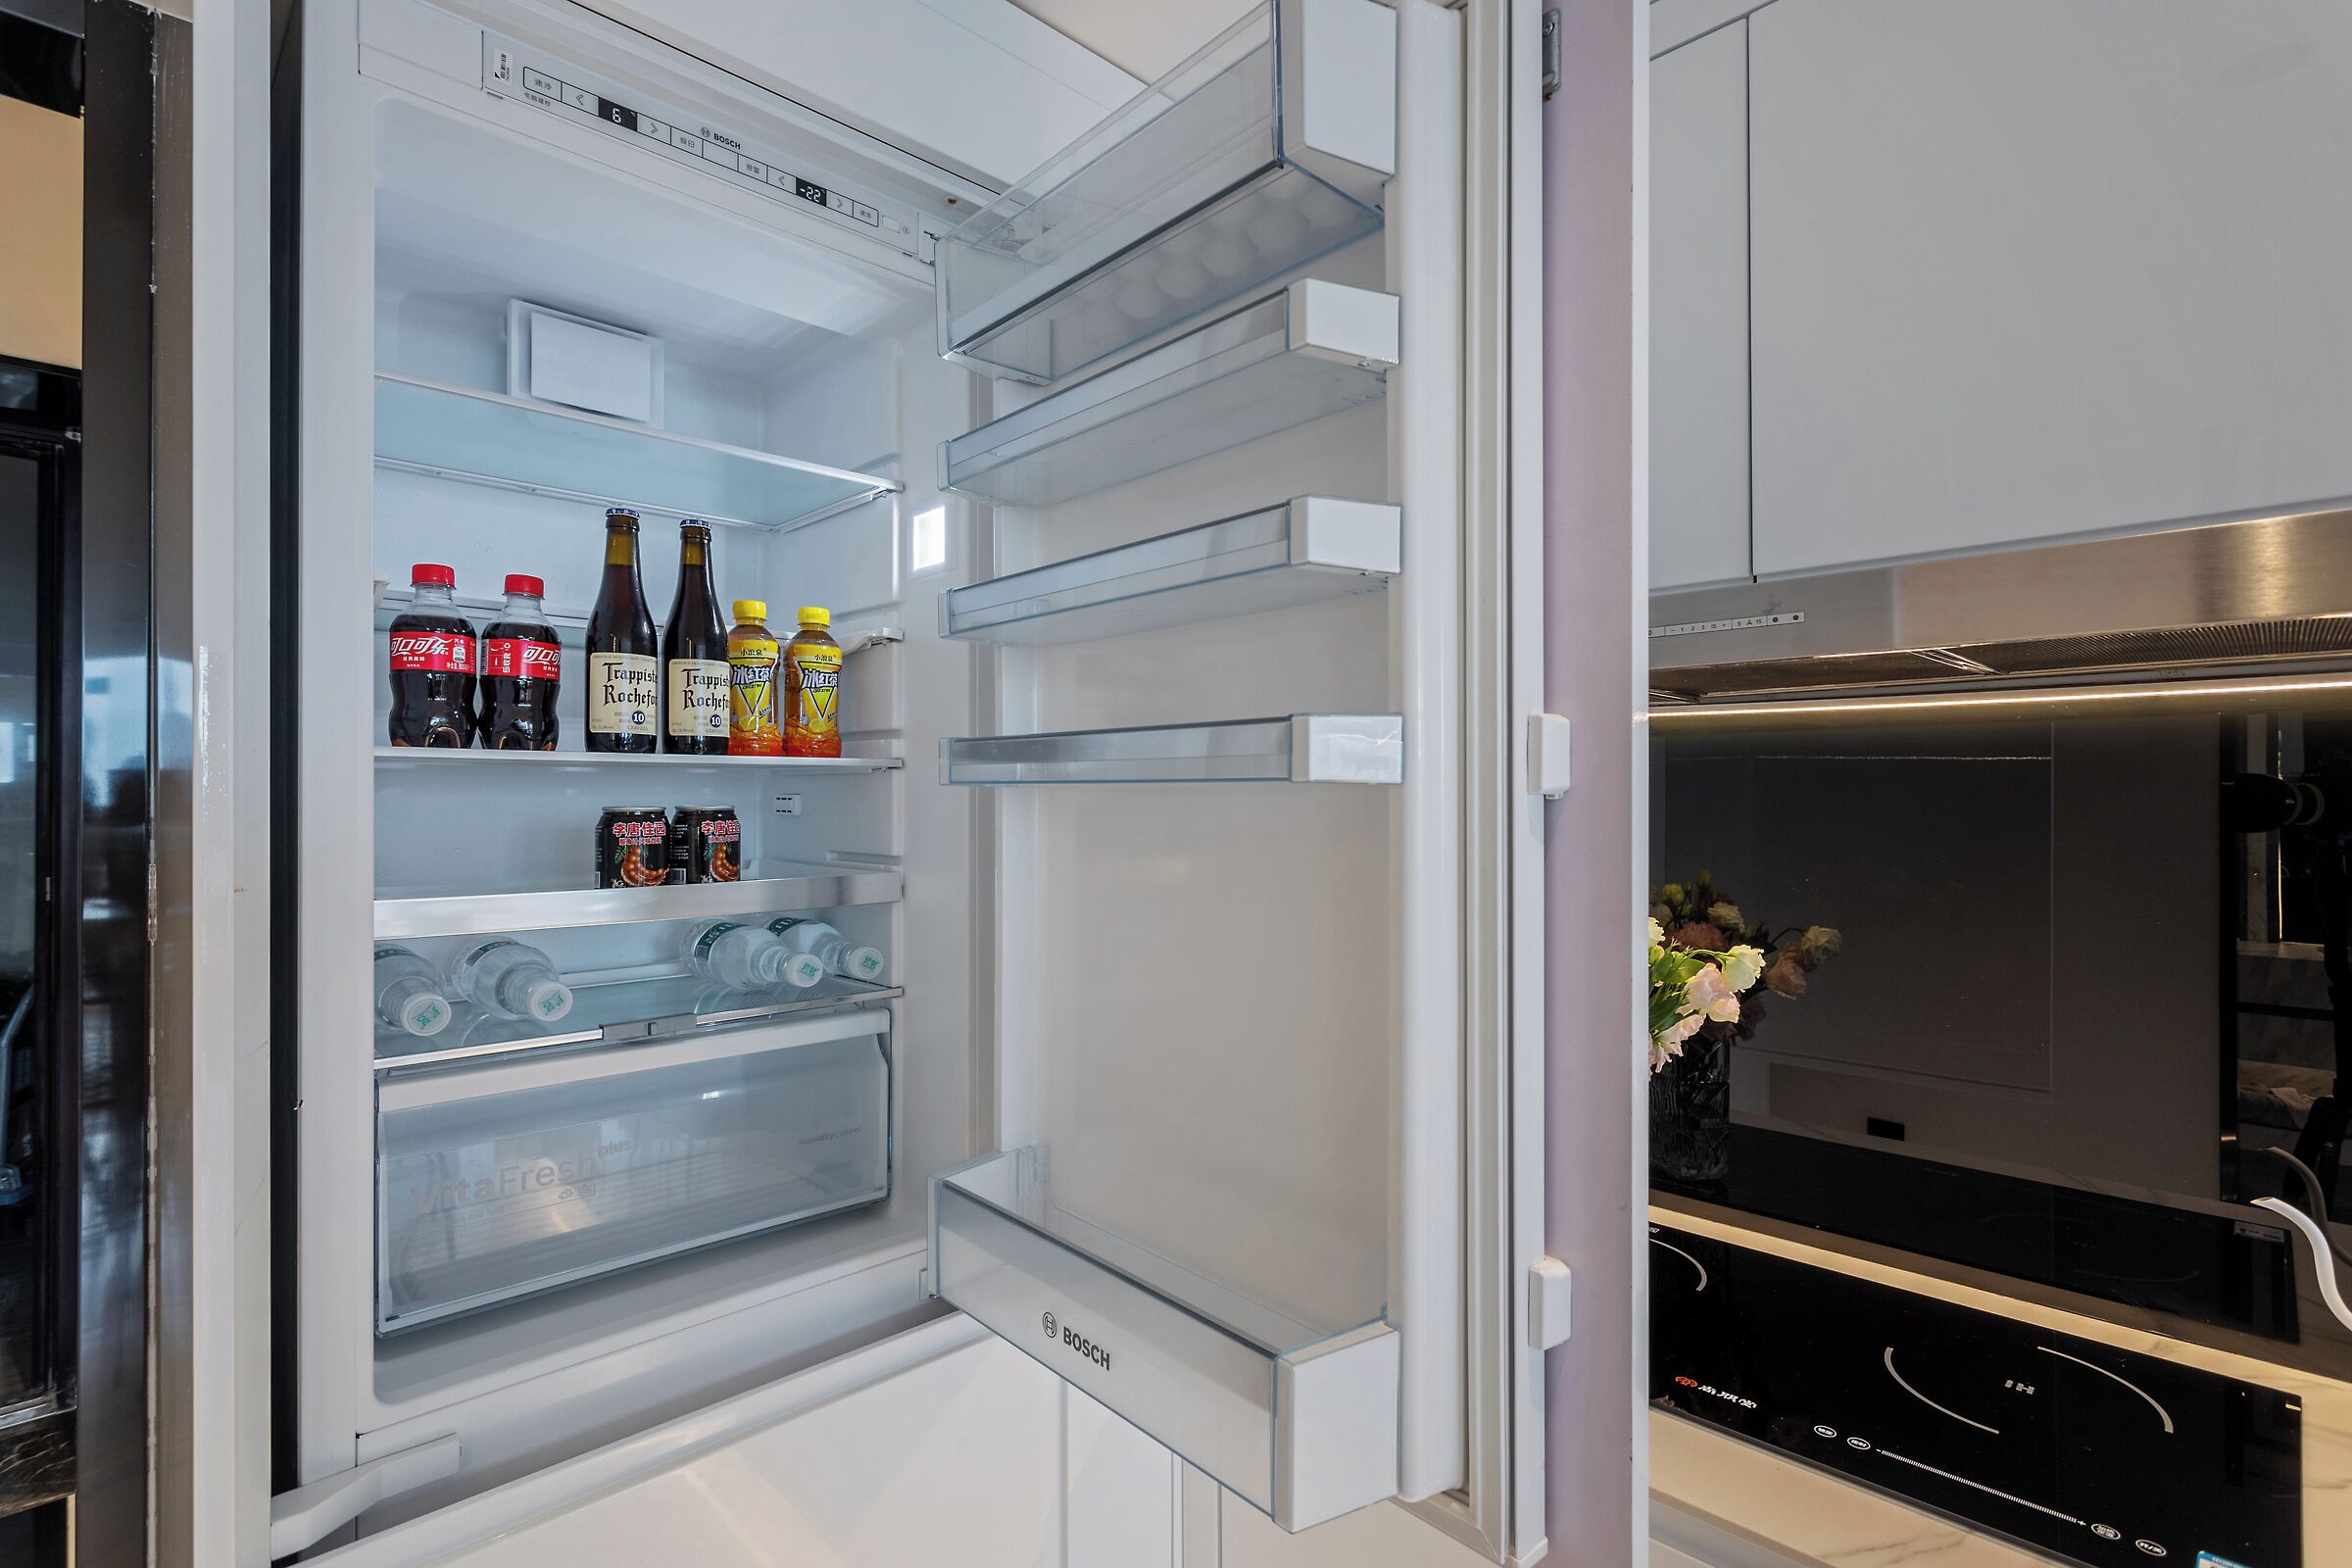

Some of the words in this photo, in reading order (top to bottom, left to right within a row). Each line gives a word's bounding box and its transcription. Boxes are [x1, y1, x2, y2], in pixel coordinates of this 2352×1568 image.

[612, 108, 621, 123] 6
[713, 132, 741, 150] BOSCH
[391, 636, 454, 657] 可口可乐
[733, 666, 770, 685] 冰红茶
[802, 670, 838, 688] 冰红茶
[633, 712, 645, 723] 10
[710, 716, 721, 725] 10
[612, 821, 666, 837] 李唐佳园
[409, 1150, 597, 1214] VitaFresh
[1063, 1326, 1109, 1371] BOSCH
